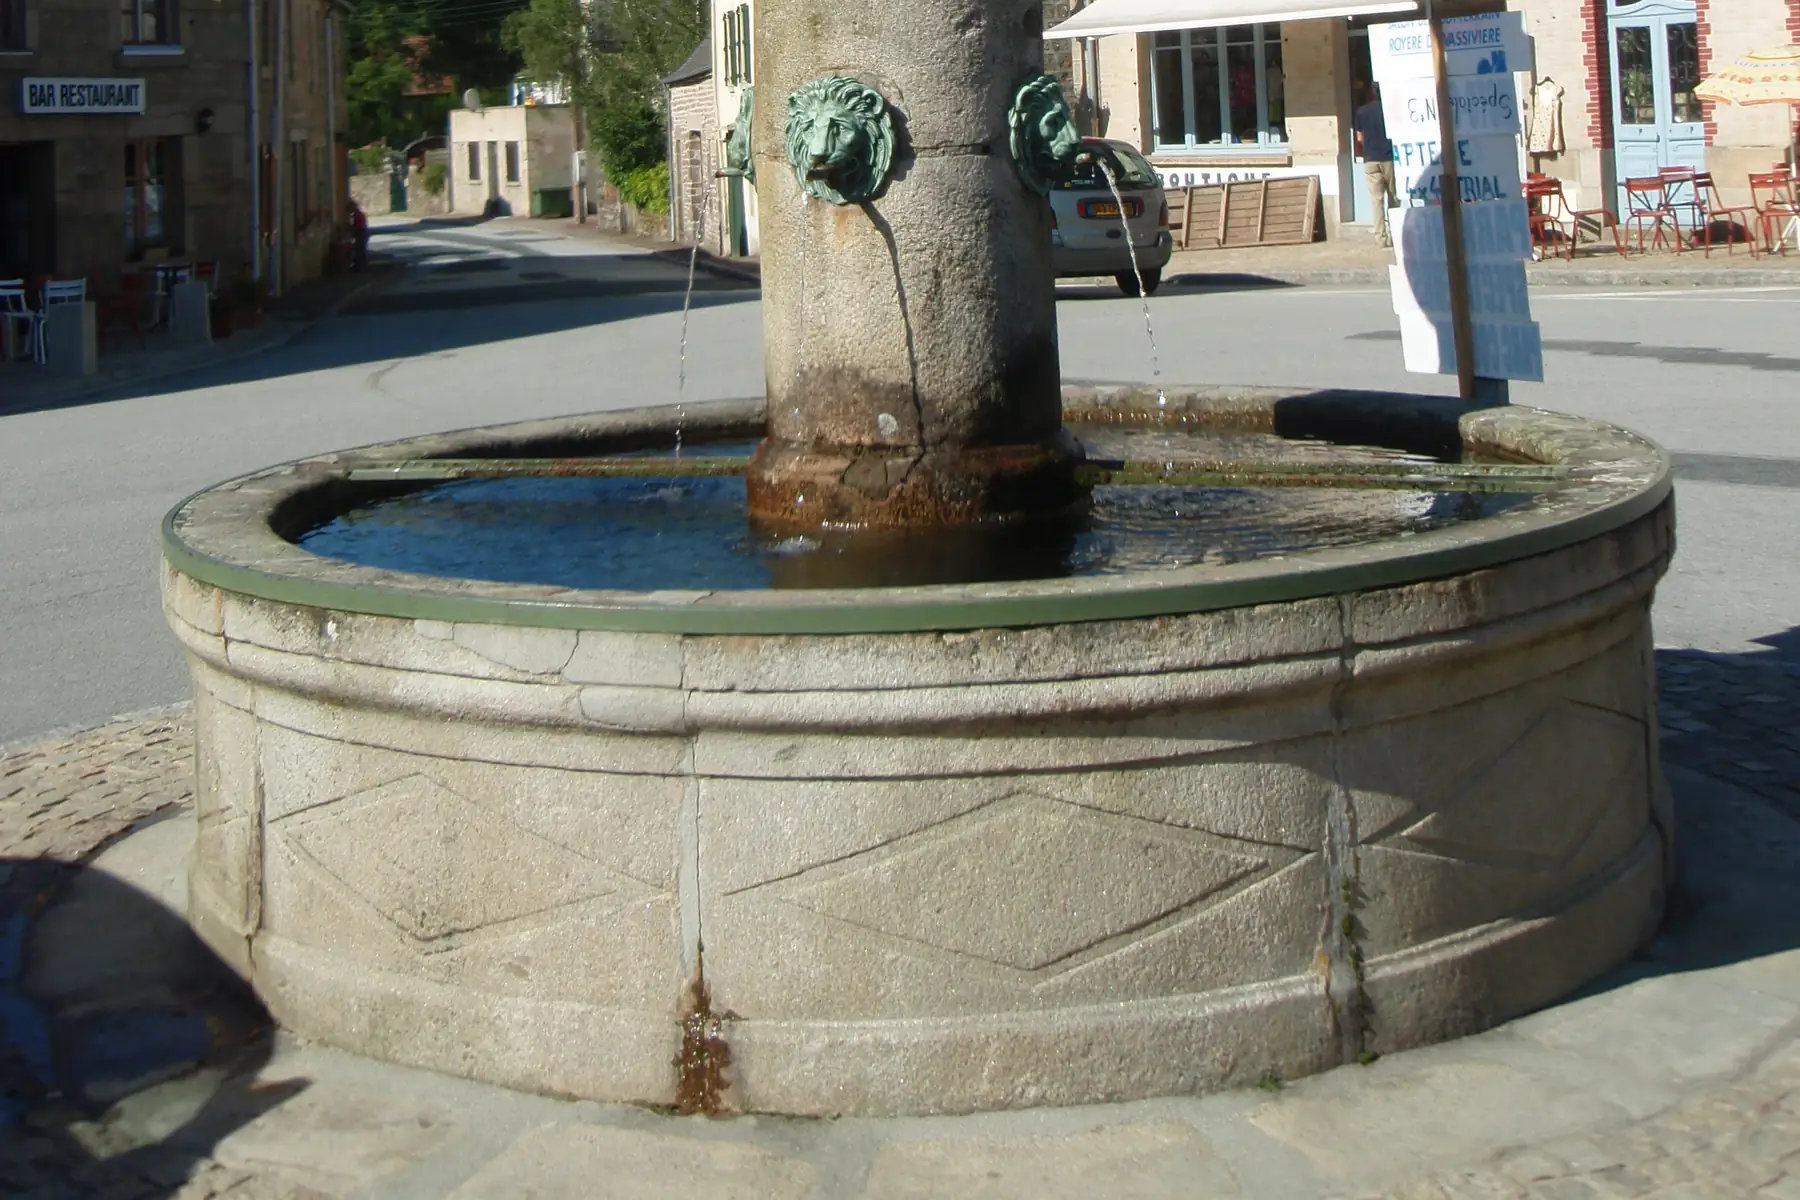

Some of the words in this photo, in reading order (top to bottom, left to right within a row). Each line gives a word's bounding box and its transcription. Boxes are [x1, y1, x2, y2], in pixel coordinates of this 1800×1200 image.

[1388, 35, 1422, 51] ROYERE
[29, 84, 56, 107] BAR
[60, 83, 140, 107] RESTAURANT
